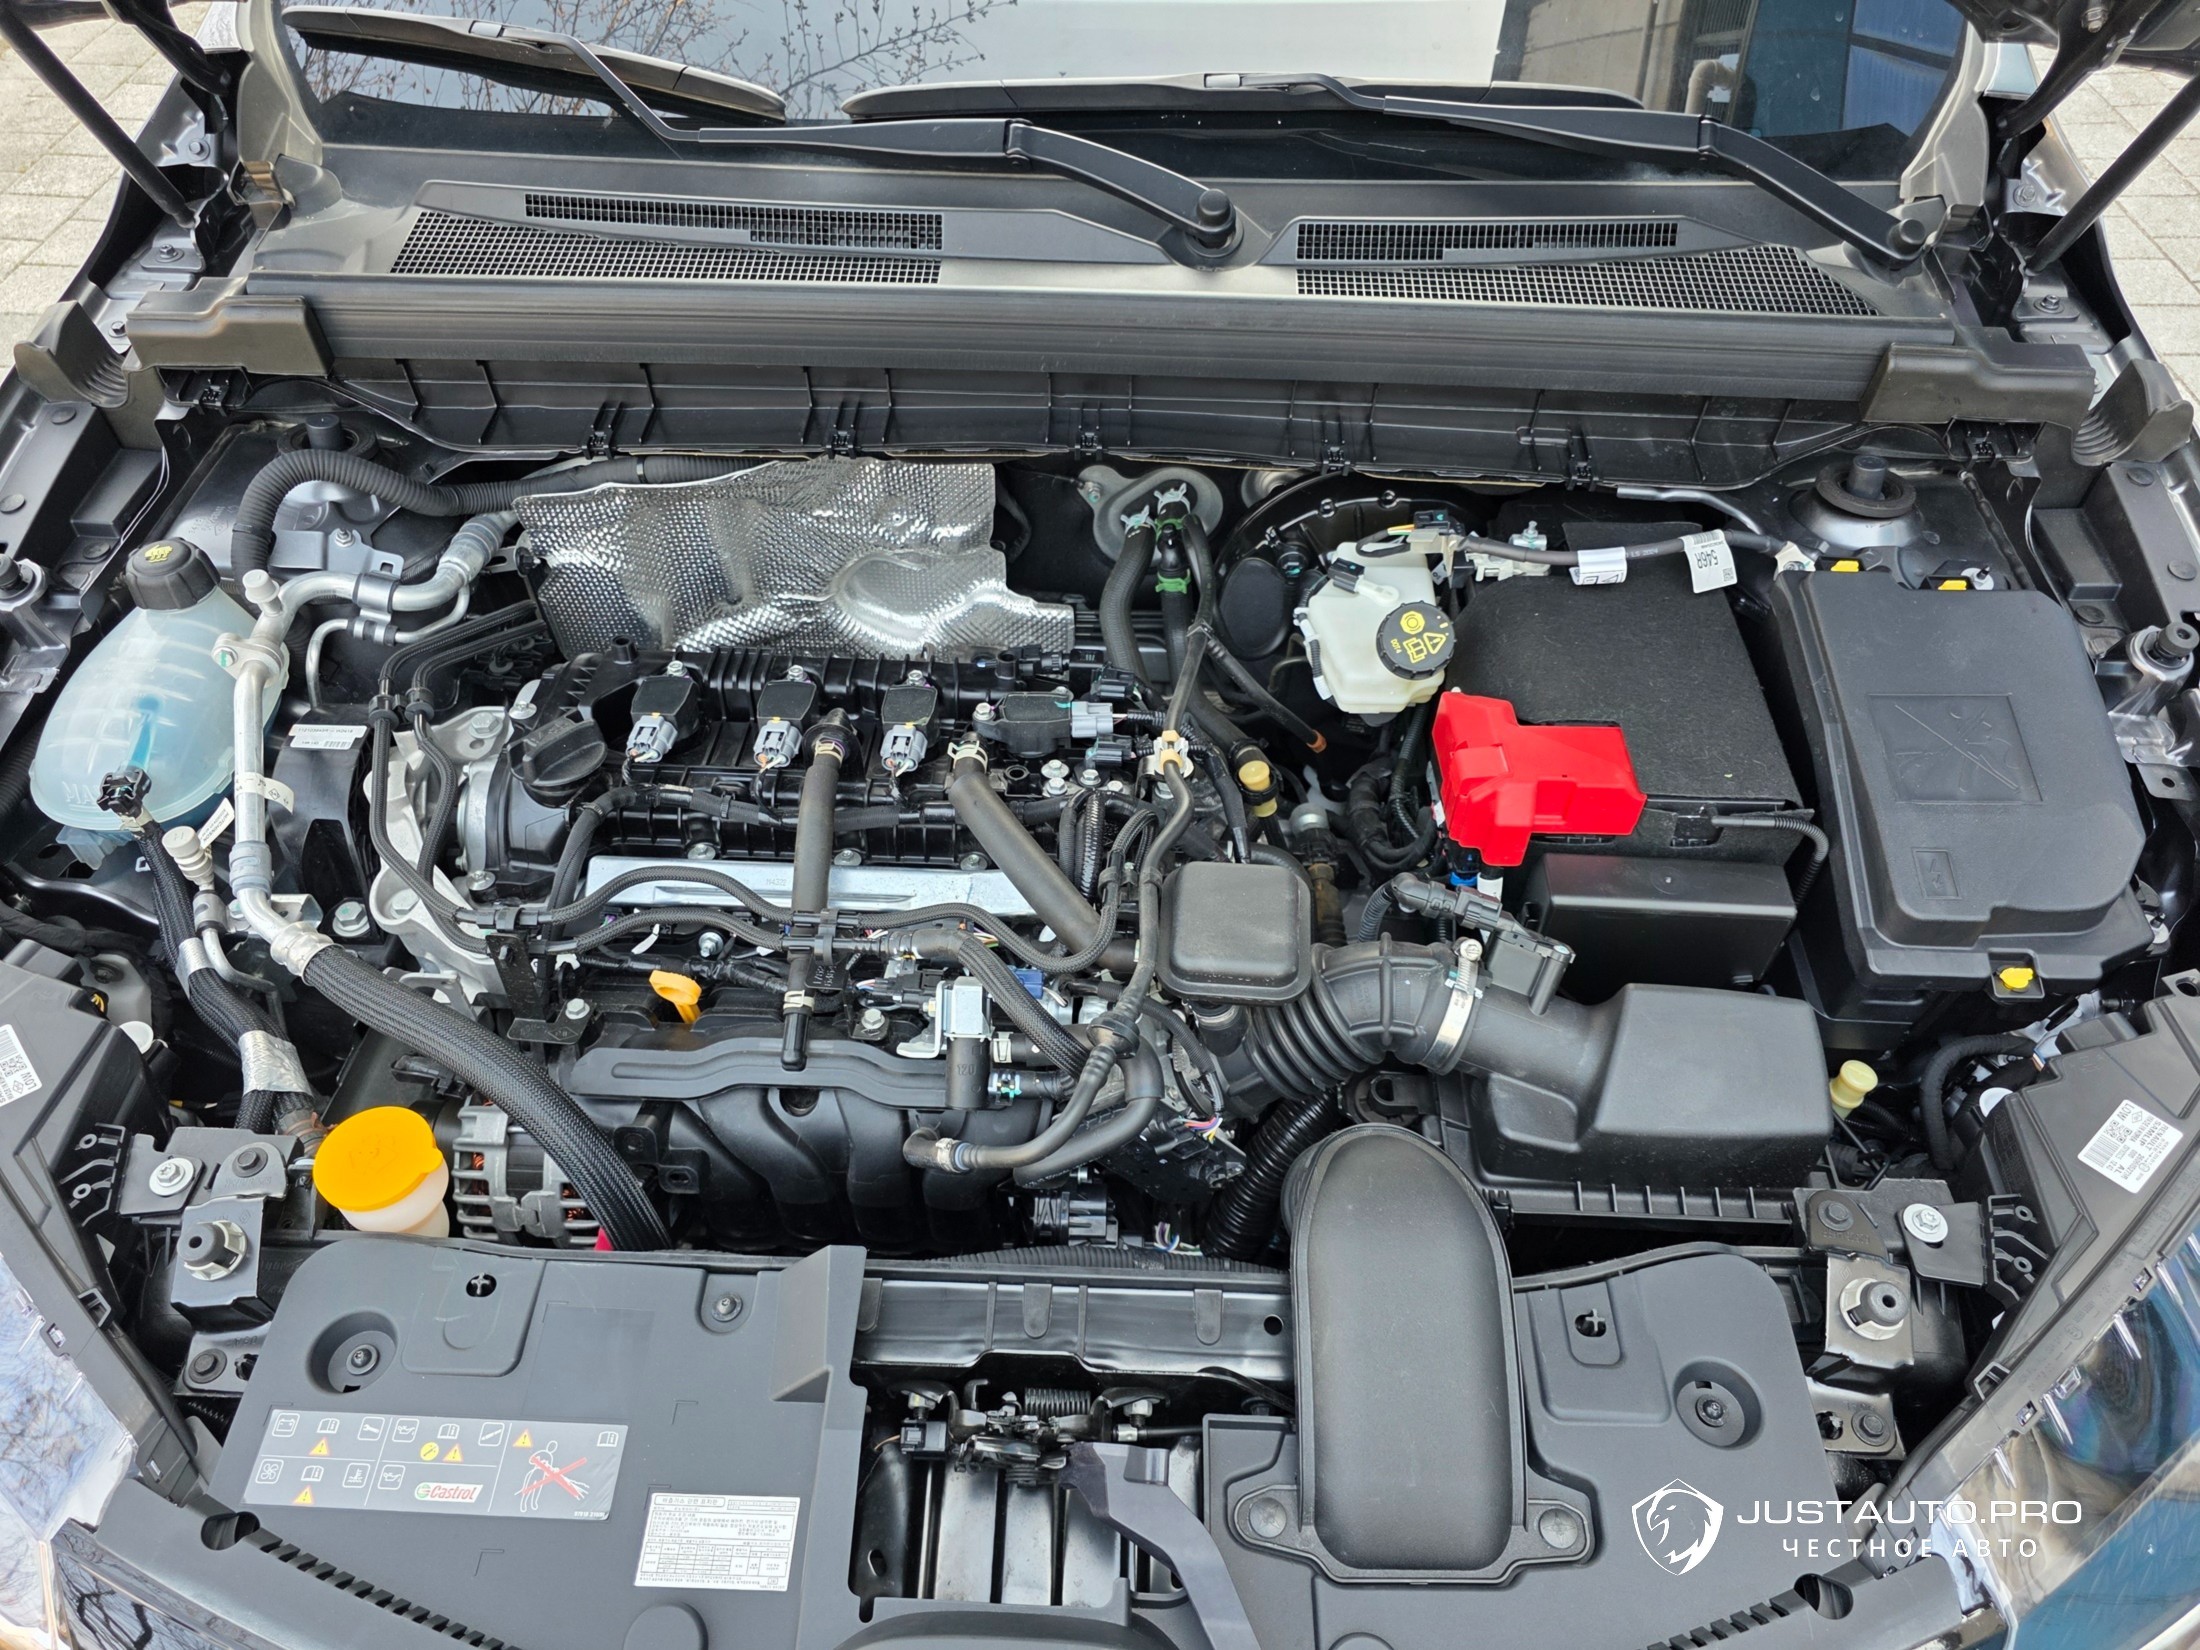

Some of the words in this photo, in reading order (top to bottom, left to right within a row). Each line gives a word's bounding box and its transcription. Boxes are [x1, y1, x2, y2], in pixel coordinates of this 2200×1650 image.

[1695, 549, 1719, 569] 546R
[20, 1071, 37, 1090] LOW
[2117, 1103, 2135, 1121] LOW
[2139, 1119, 2162, 1147] SAMLIP
[2145, 1124, 2169, 1151] RENAULT
[430, 1485, 478, 1501] Castrol
